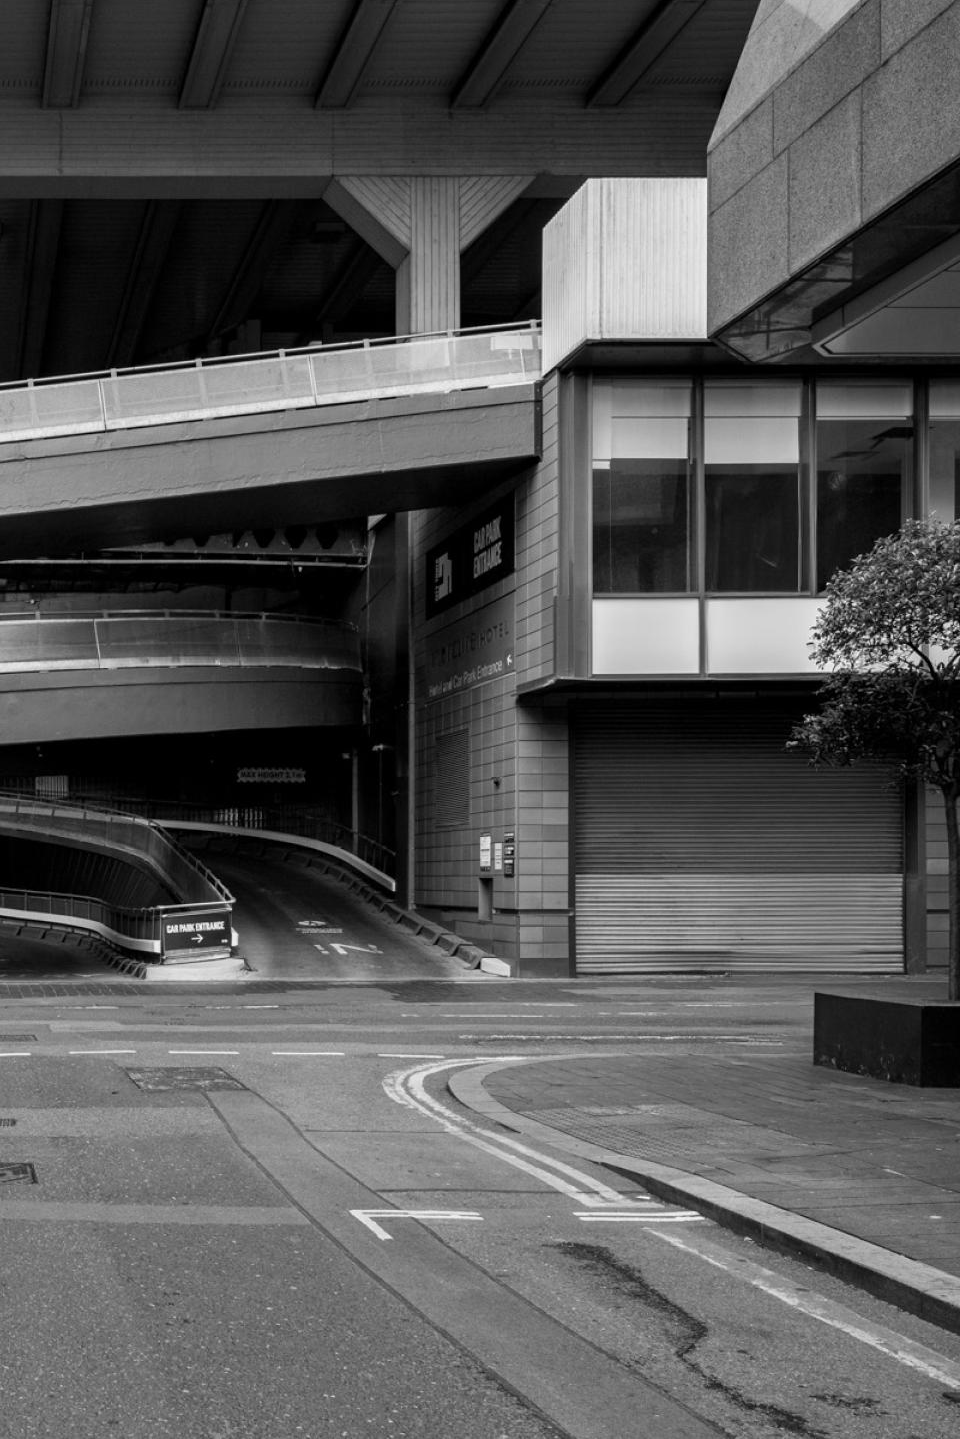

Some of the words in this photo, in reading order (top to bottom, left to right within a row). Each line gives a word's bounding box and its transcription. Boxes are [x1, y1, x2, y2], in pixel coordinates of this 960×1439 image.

[473, 526, 486, 554] CAR
[486, 515, 502, 548] PARK
[473, 541, 502, 579] ENTRANCE
[479, 620, 509, 649] HOTEL
[464, 669, 476, 685] Park
[477, 659, 503, 680] Entrance
[166, 924, 179, 934] CAR
[179, 922, 195, 933] PARK
[195, 921, 225, 932] ENTRANCE
